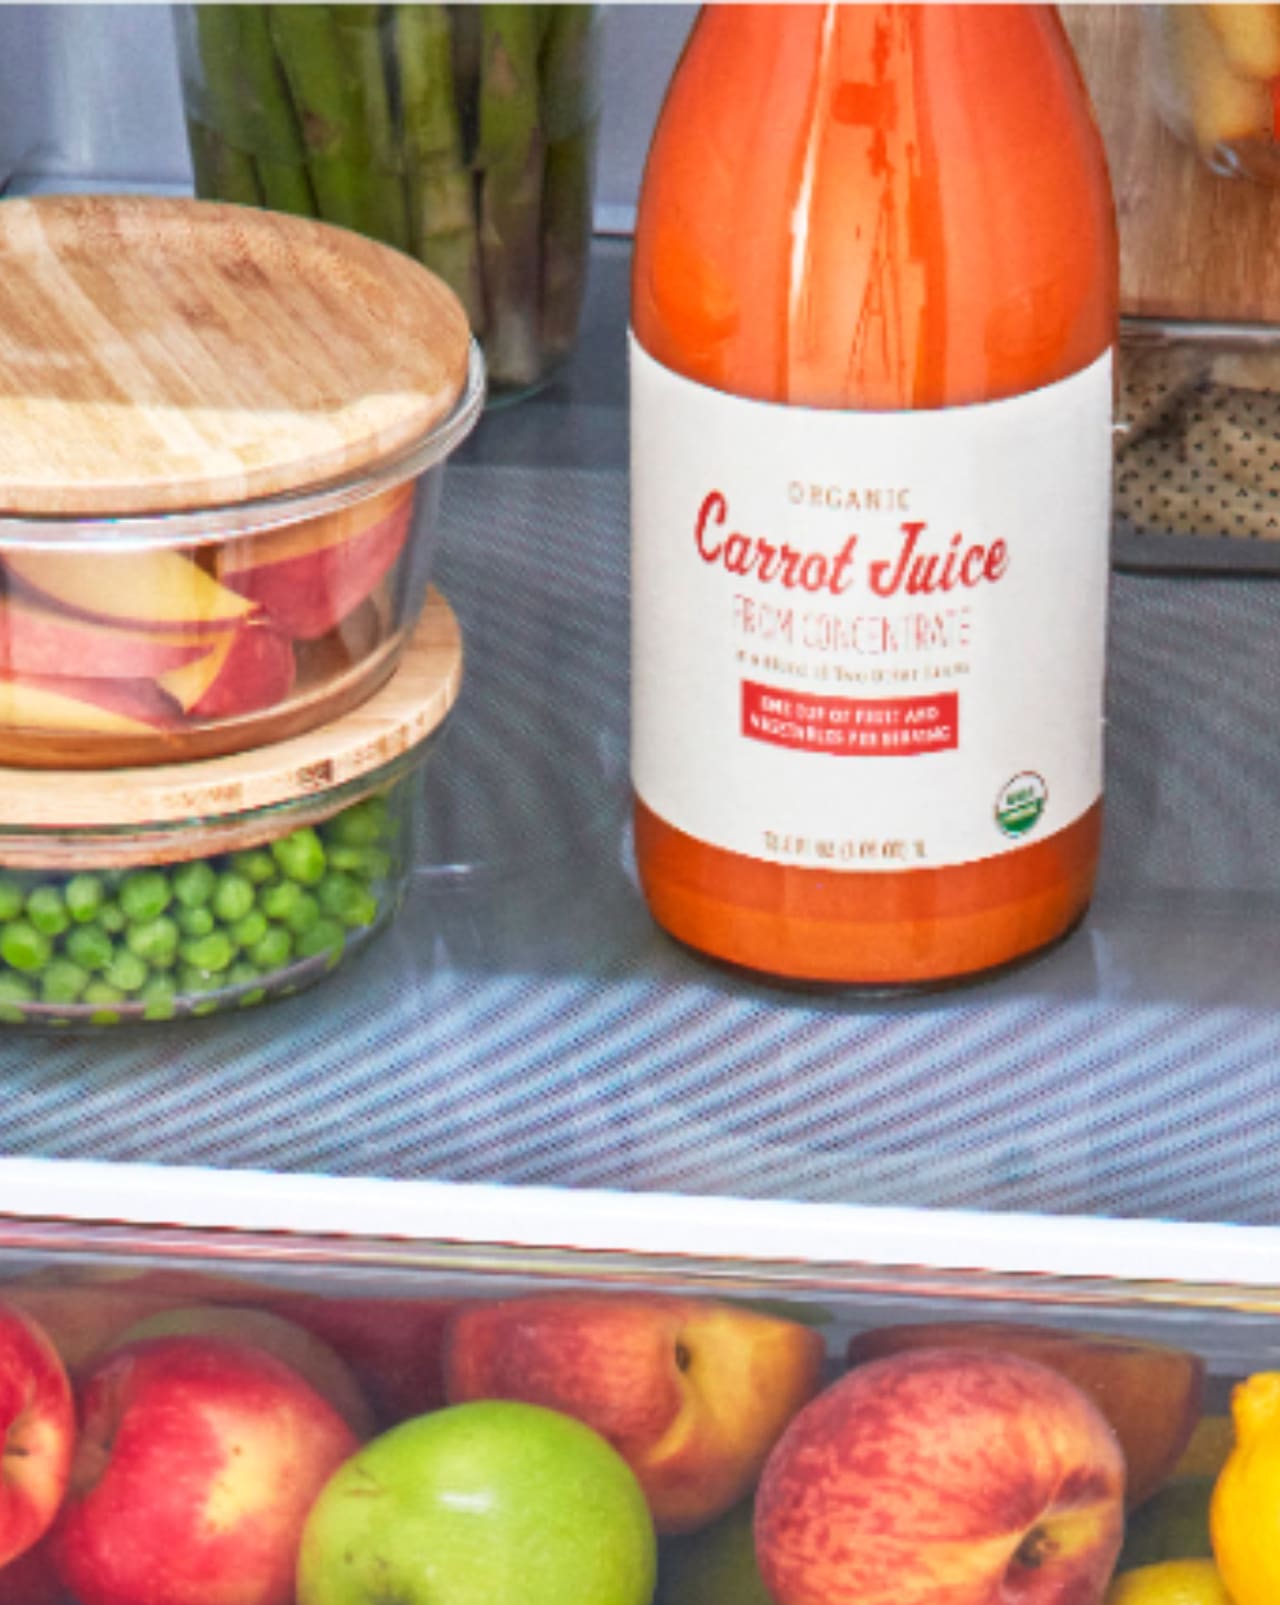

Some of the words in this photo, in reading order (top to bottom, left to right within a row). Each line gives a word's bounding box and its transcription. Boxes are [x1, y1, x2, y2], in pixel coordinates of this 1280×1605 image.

[787, 480, 910, 512] ORGANIC
[695, 489, 859, 596] Carrot
[869, 520, 1011, 598] Juice
[802, 606, 971, 655] CONCENTRATE
